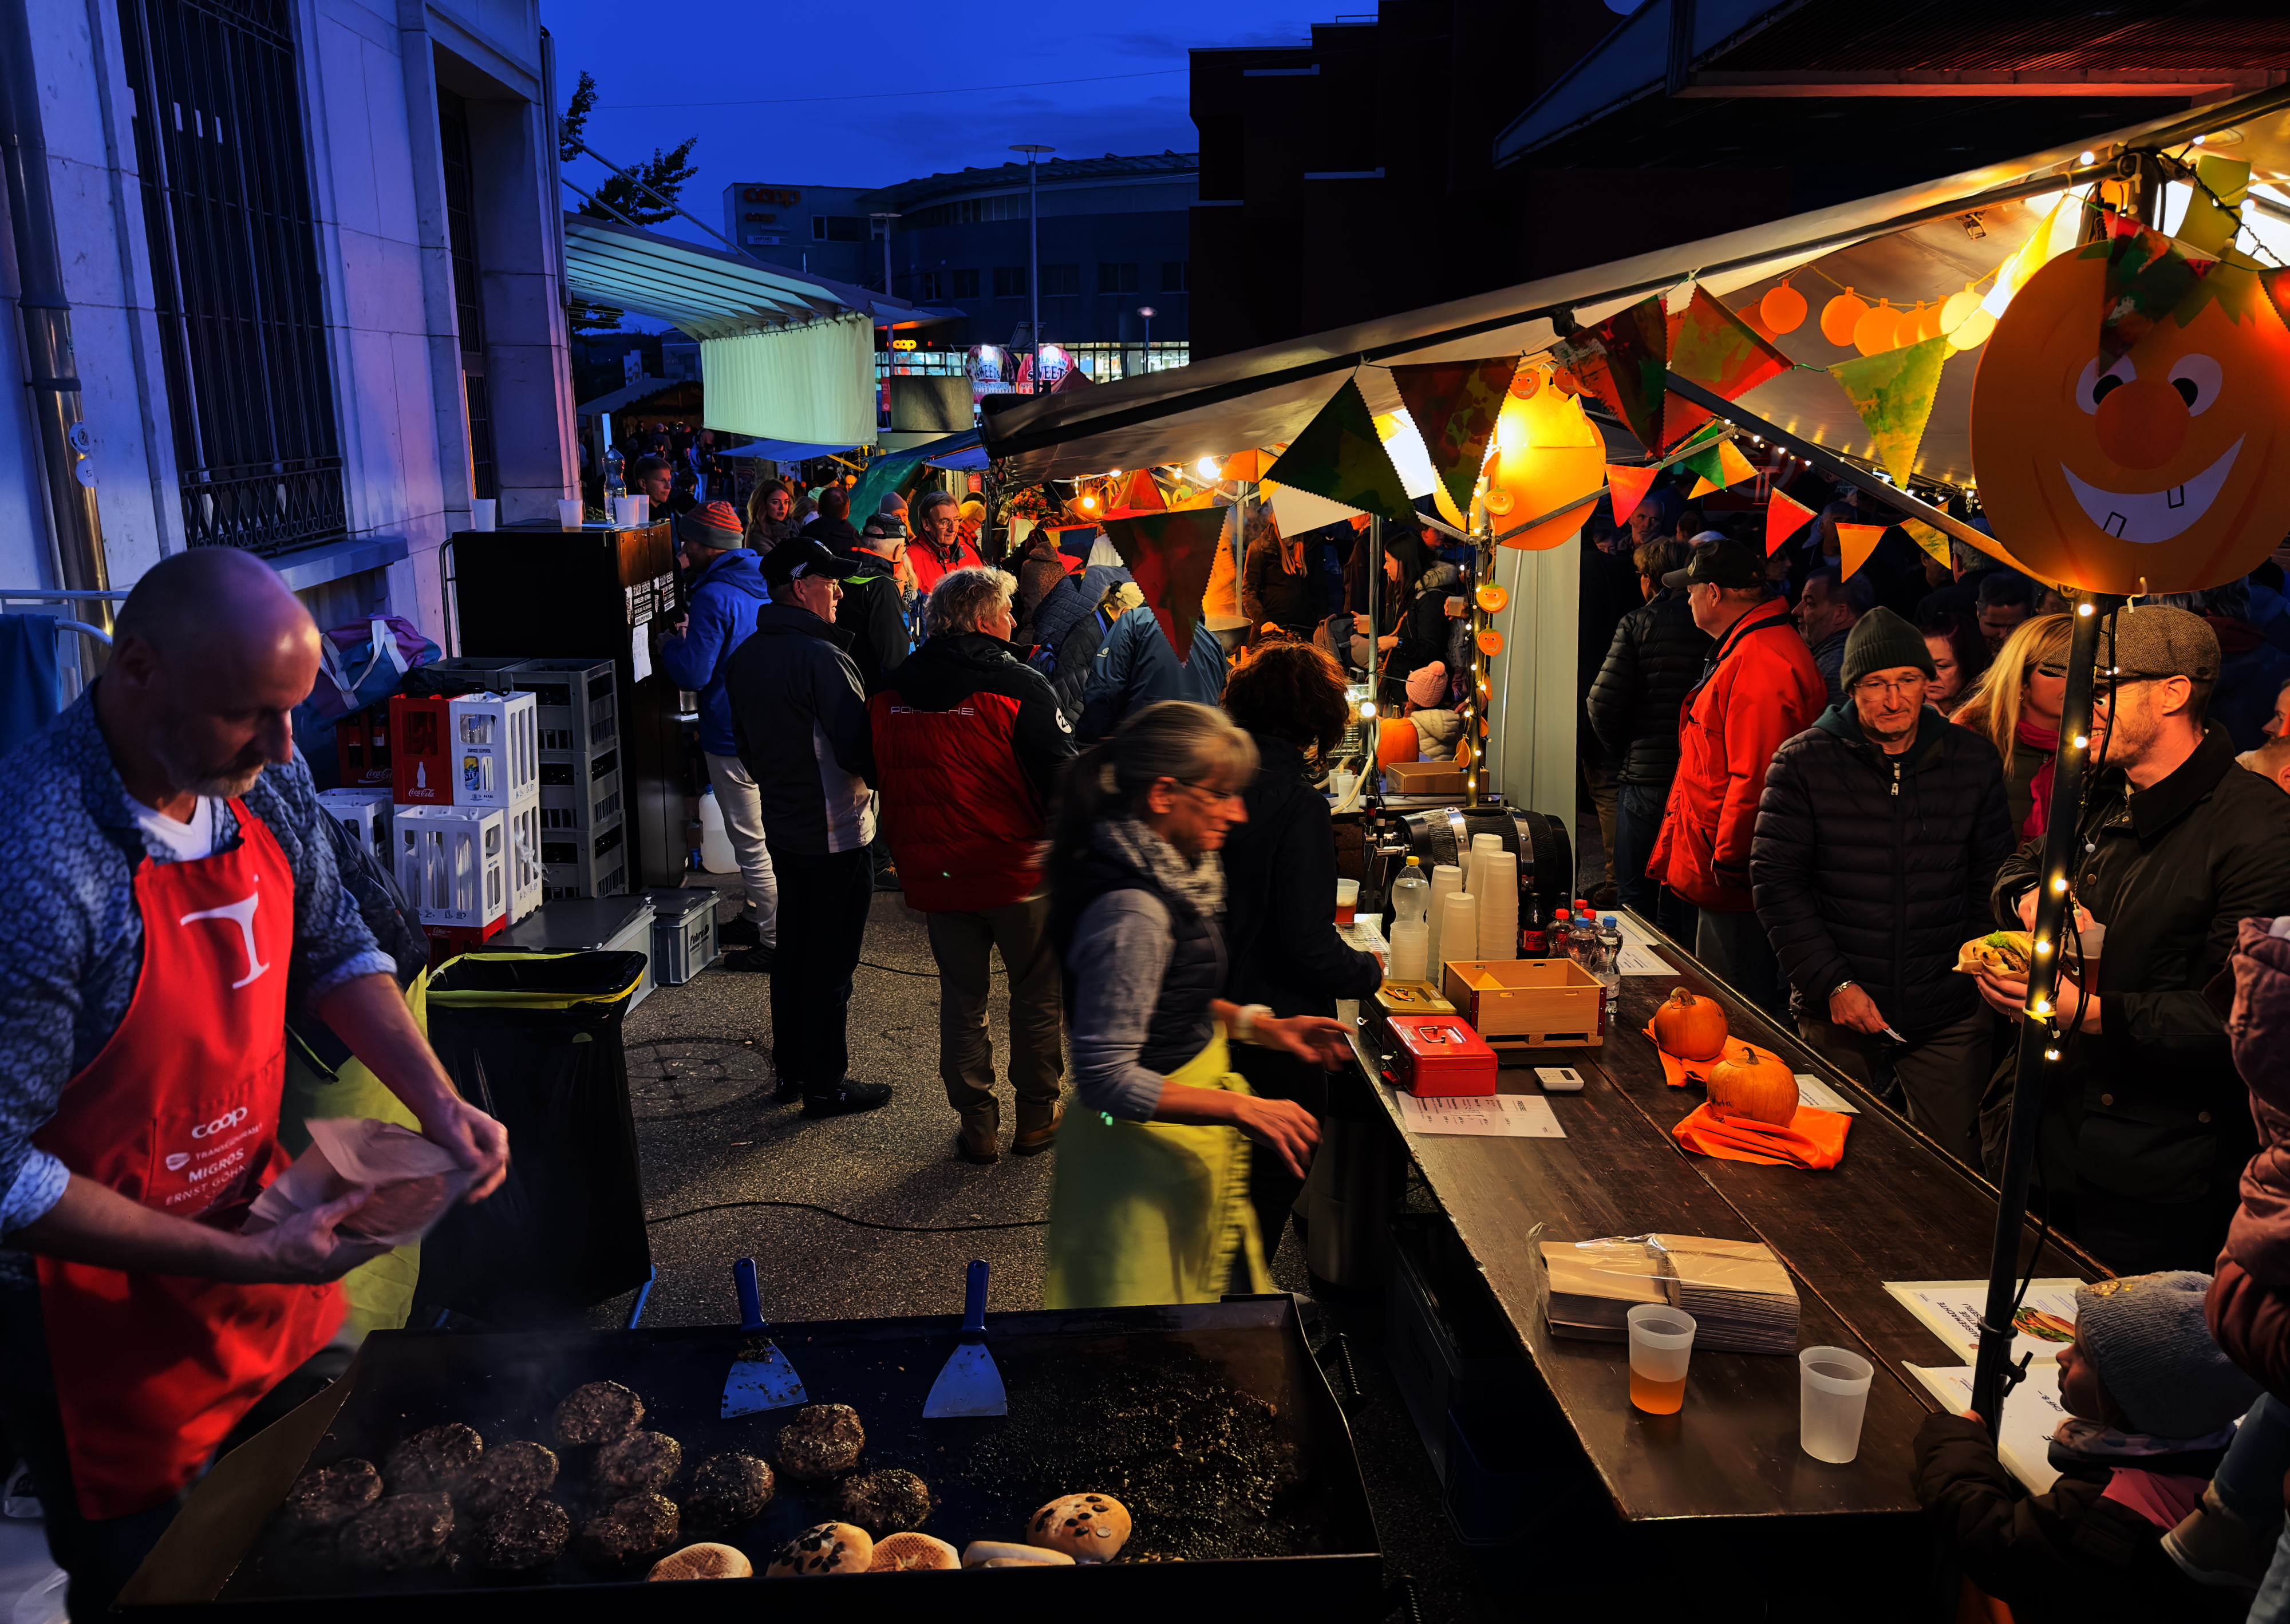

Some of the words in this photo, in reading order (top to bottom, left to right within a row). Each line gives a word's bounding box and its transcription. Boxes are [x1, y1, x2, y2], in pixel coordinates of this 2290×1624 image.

[745, 188, 801, 208] coop
[976, 365, 1000, 378] SWEETS
[192, 1107, 247, 1139] coop
[189, 1148, 244, 1183] MIGROS
[165, 1183, 208, 1206] ERNST
[2046, 1400, 2063, 1412] CHF
